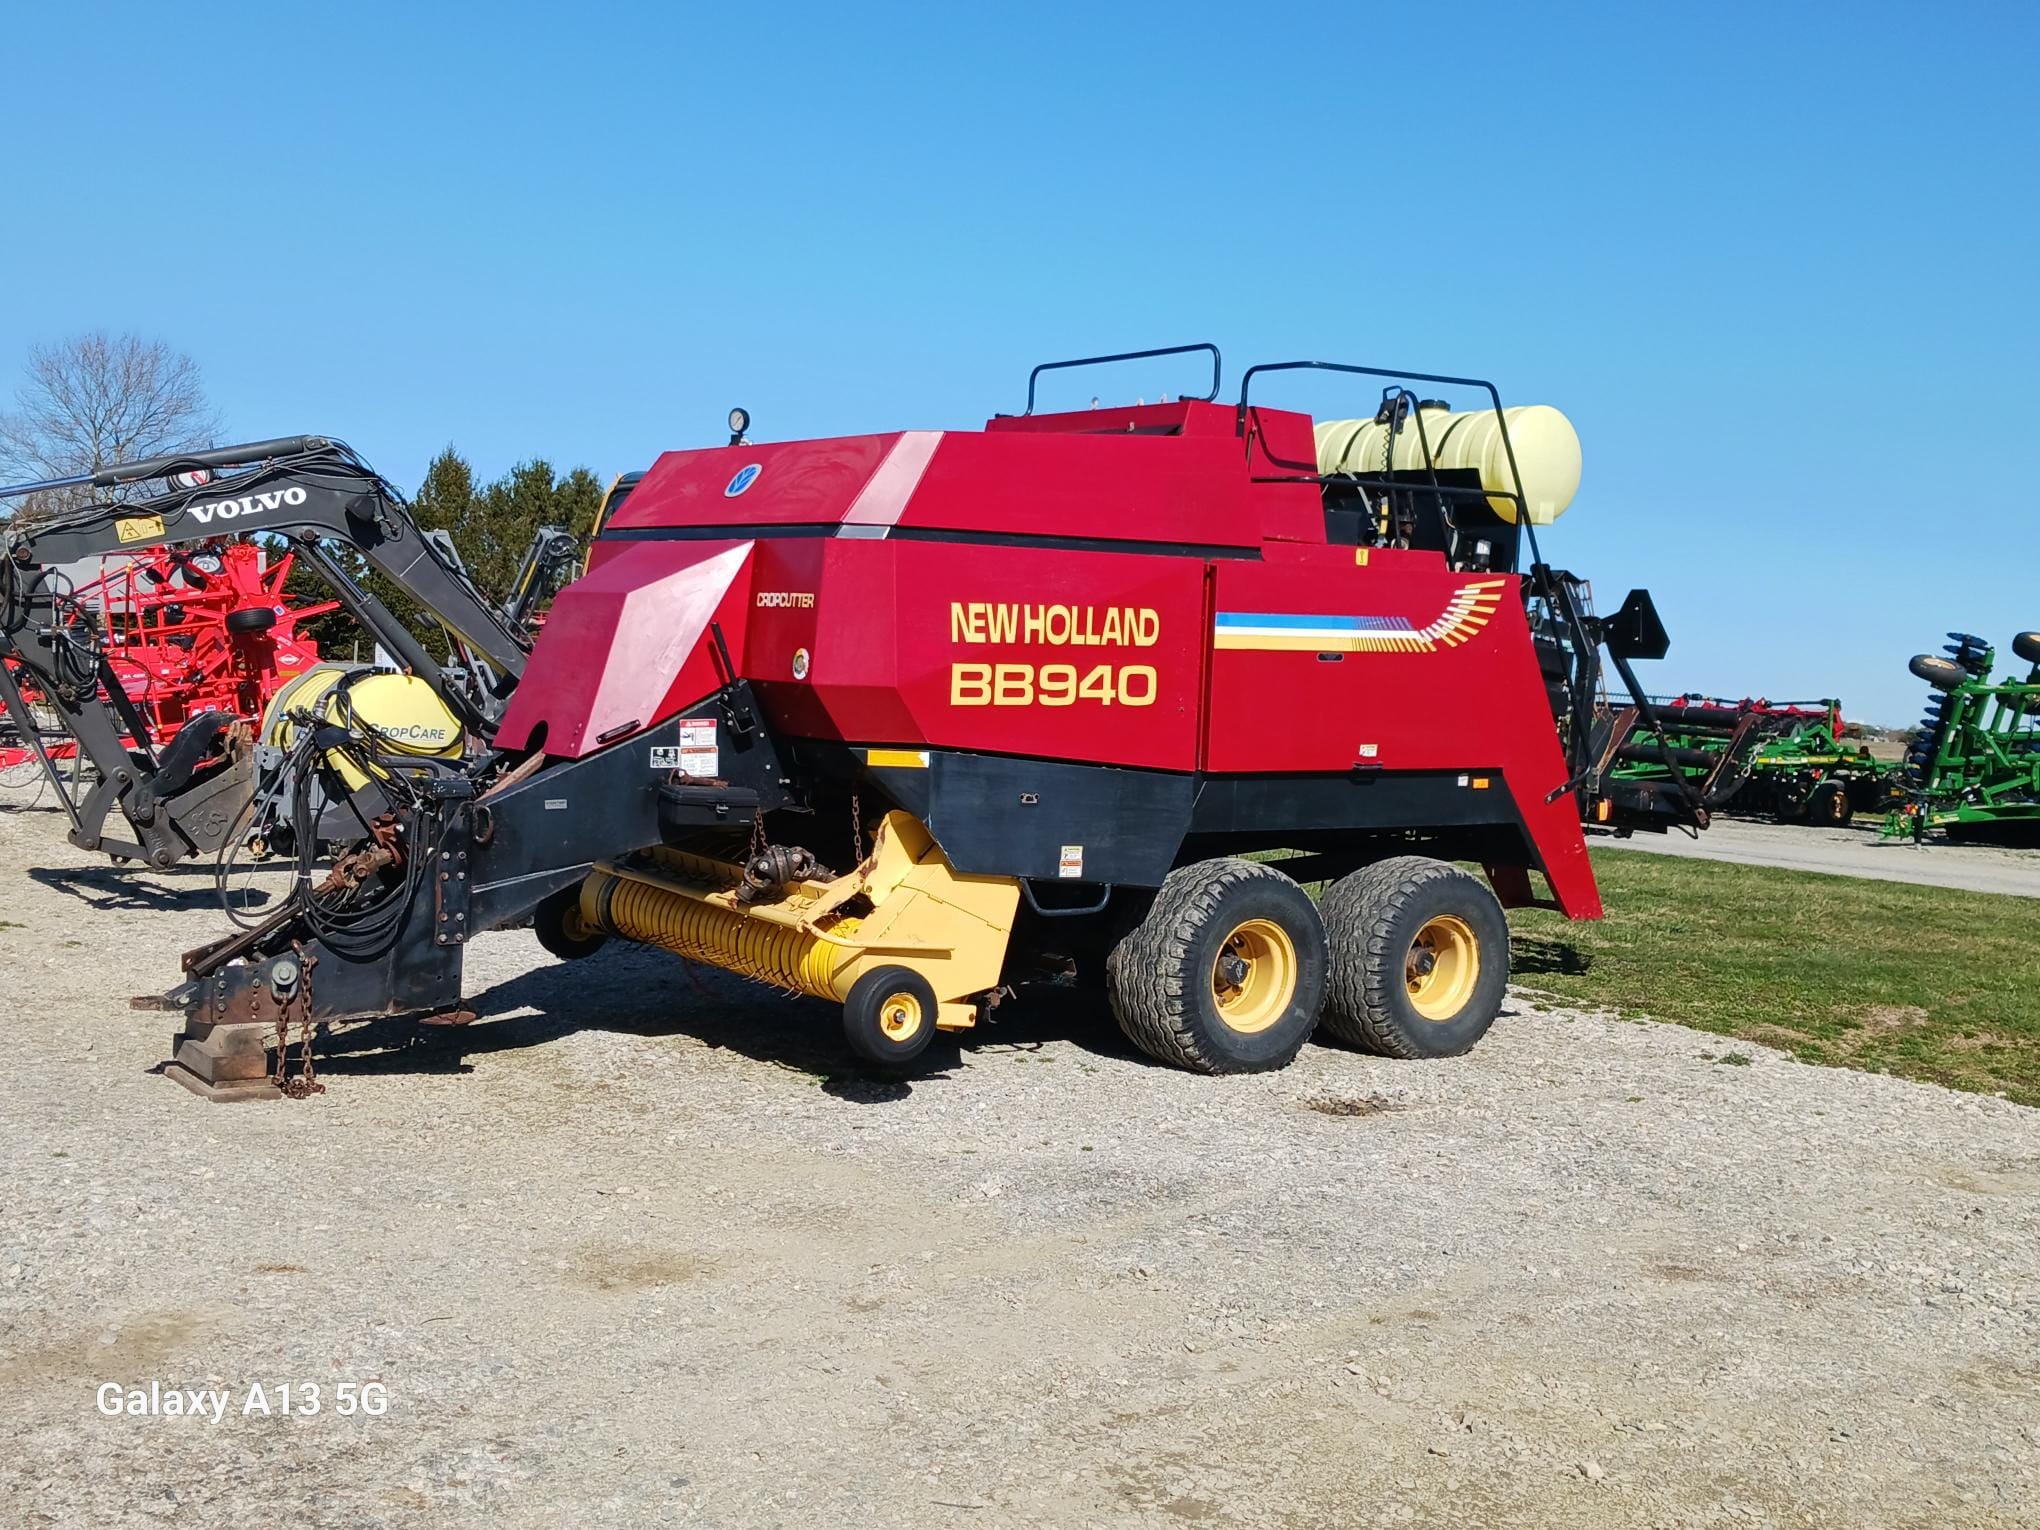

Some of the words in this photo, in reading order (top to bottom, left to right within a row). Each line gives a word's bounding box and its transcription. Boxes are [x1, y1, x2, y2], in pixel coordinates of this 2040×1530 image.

[186, 487, 307, 524] VOLVO
[756, 592, 815, 608] CROPCUTTER
[950, 602, 1019, 644] NEW
[1023, 604, 1160, 647] HOLLAND
[950, 663, 1157, 706] BB940
